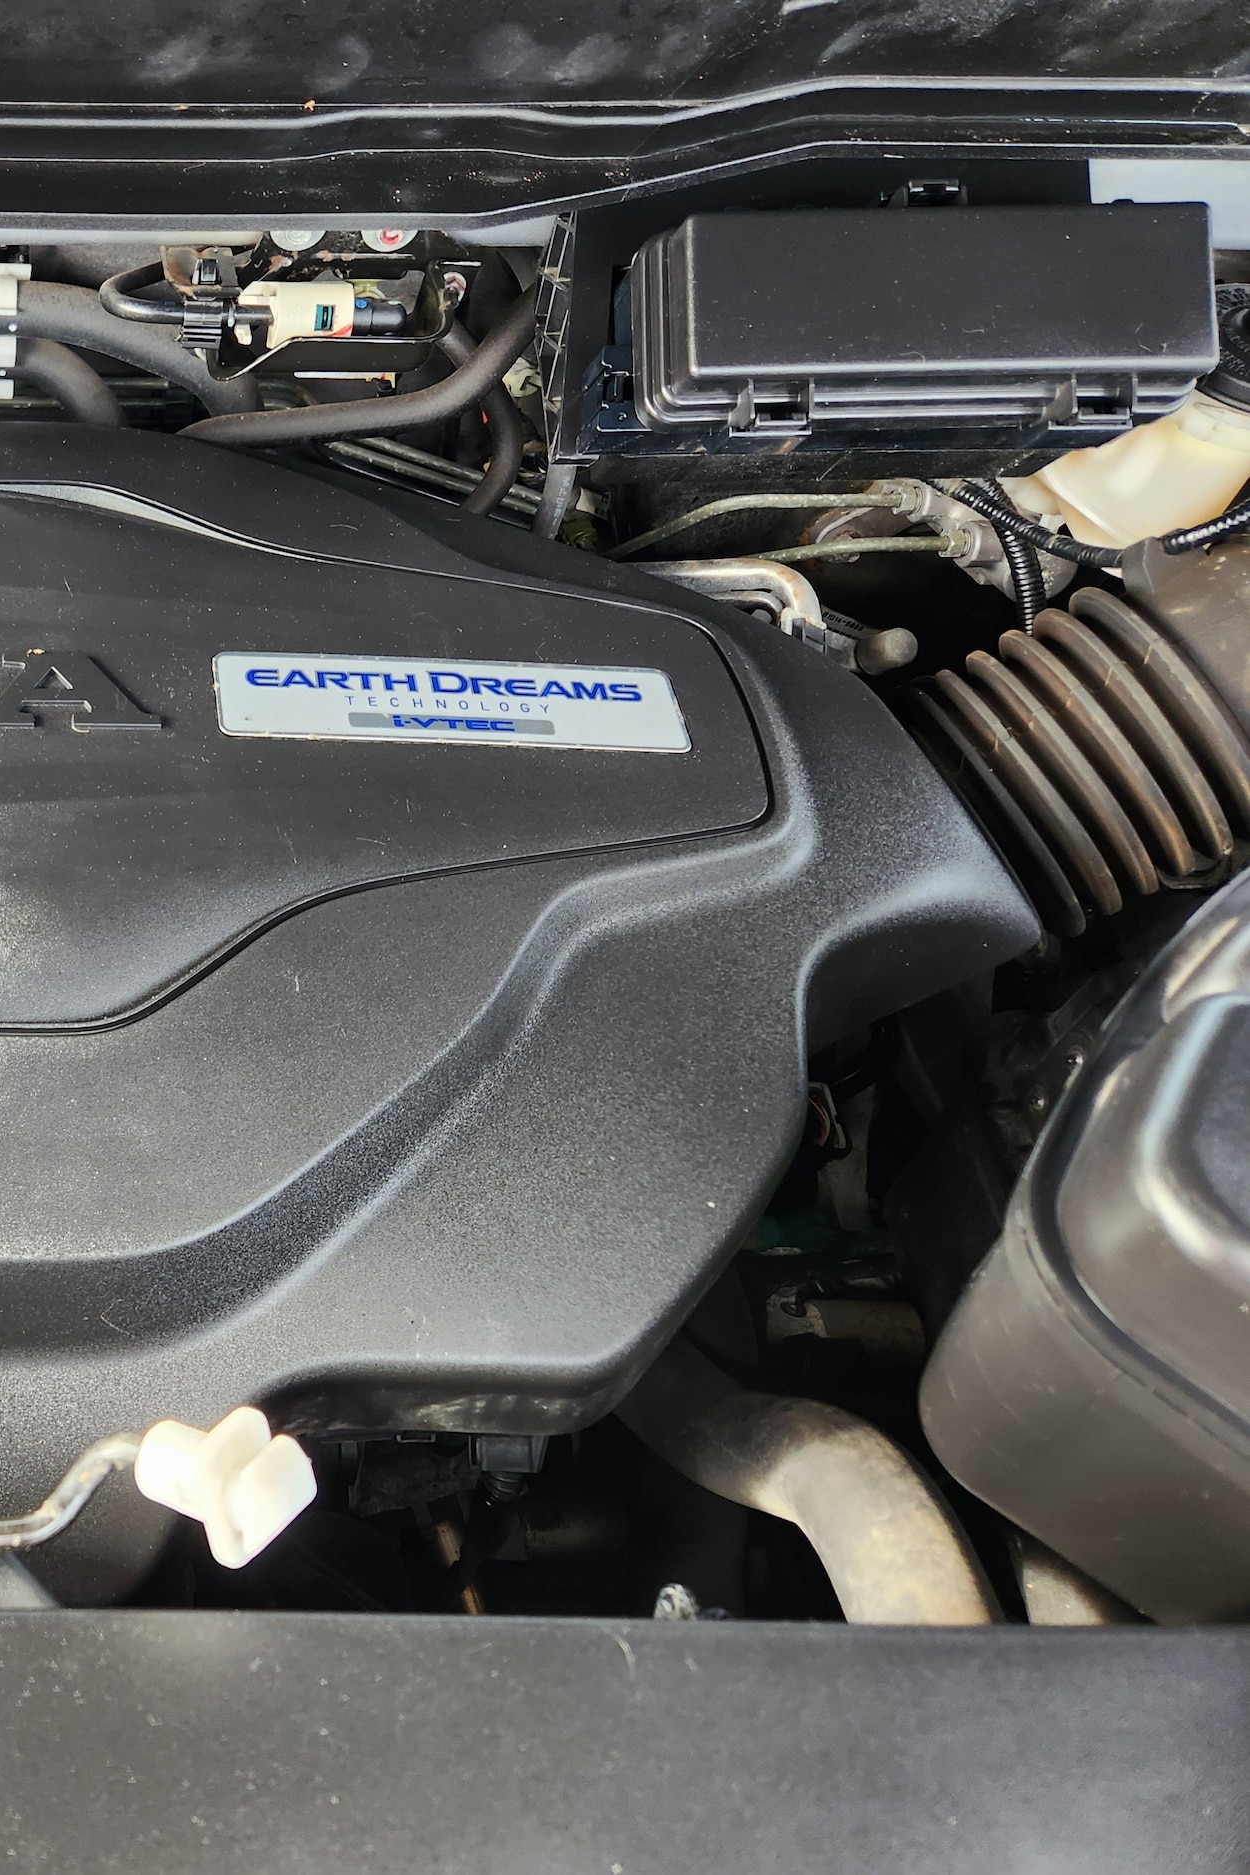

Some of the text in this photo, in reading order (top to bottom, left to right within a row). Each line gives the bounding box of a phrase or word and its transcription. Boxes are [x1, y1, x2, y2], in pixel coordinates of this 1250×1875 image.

[245, 669, 643, 702] EARTH DREAMS
[345, 696, 549, 714] TECHNOLOGY
[393, 715, 516, 732] i-VTEC
